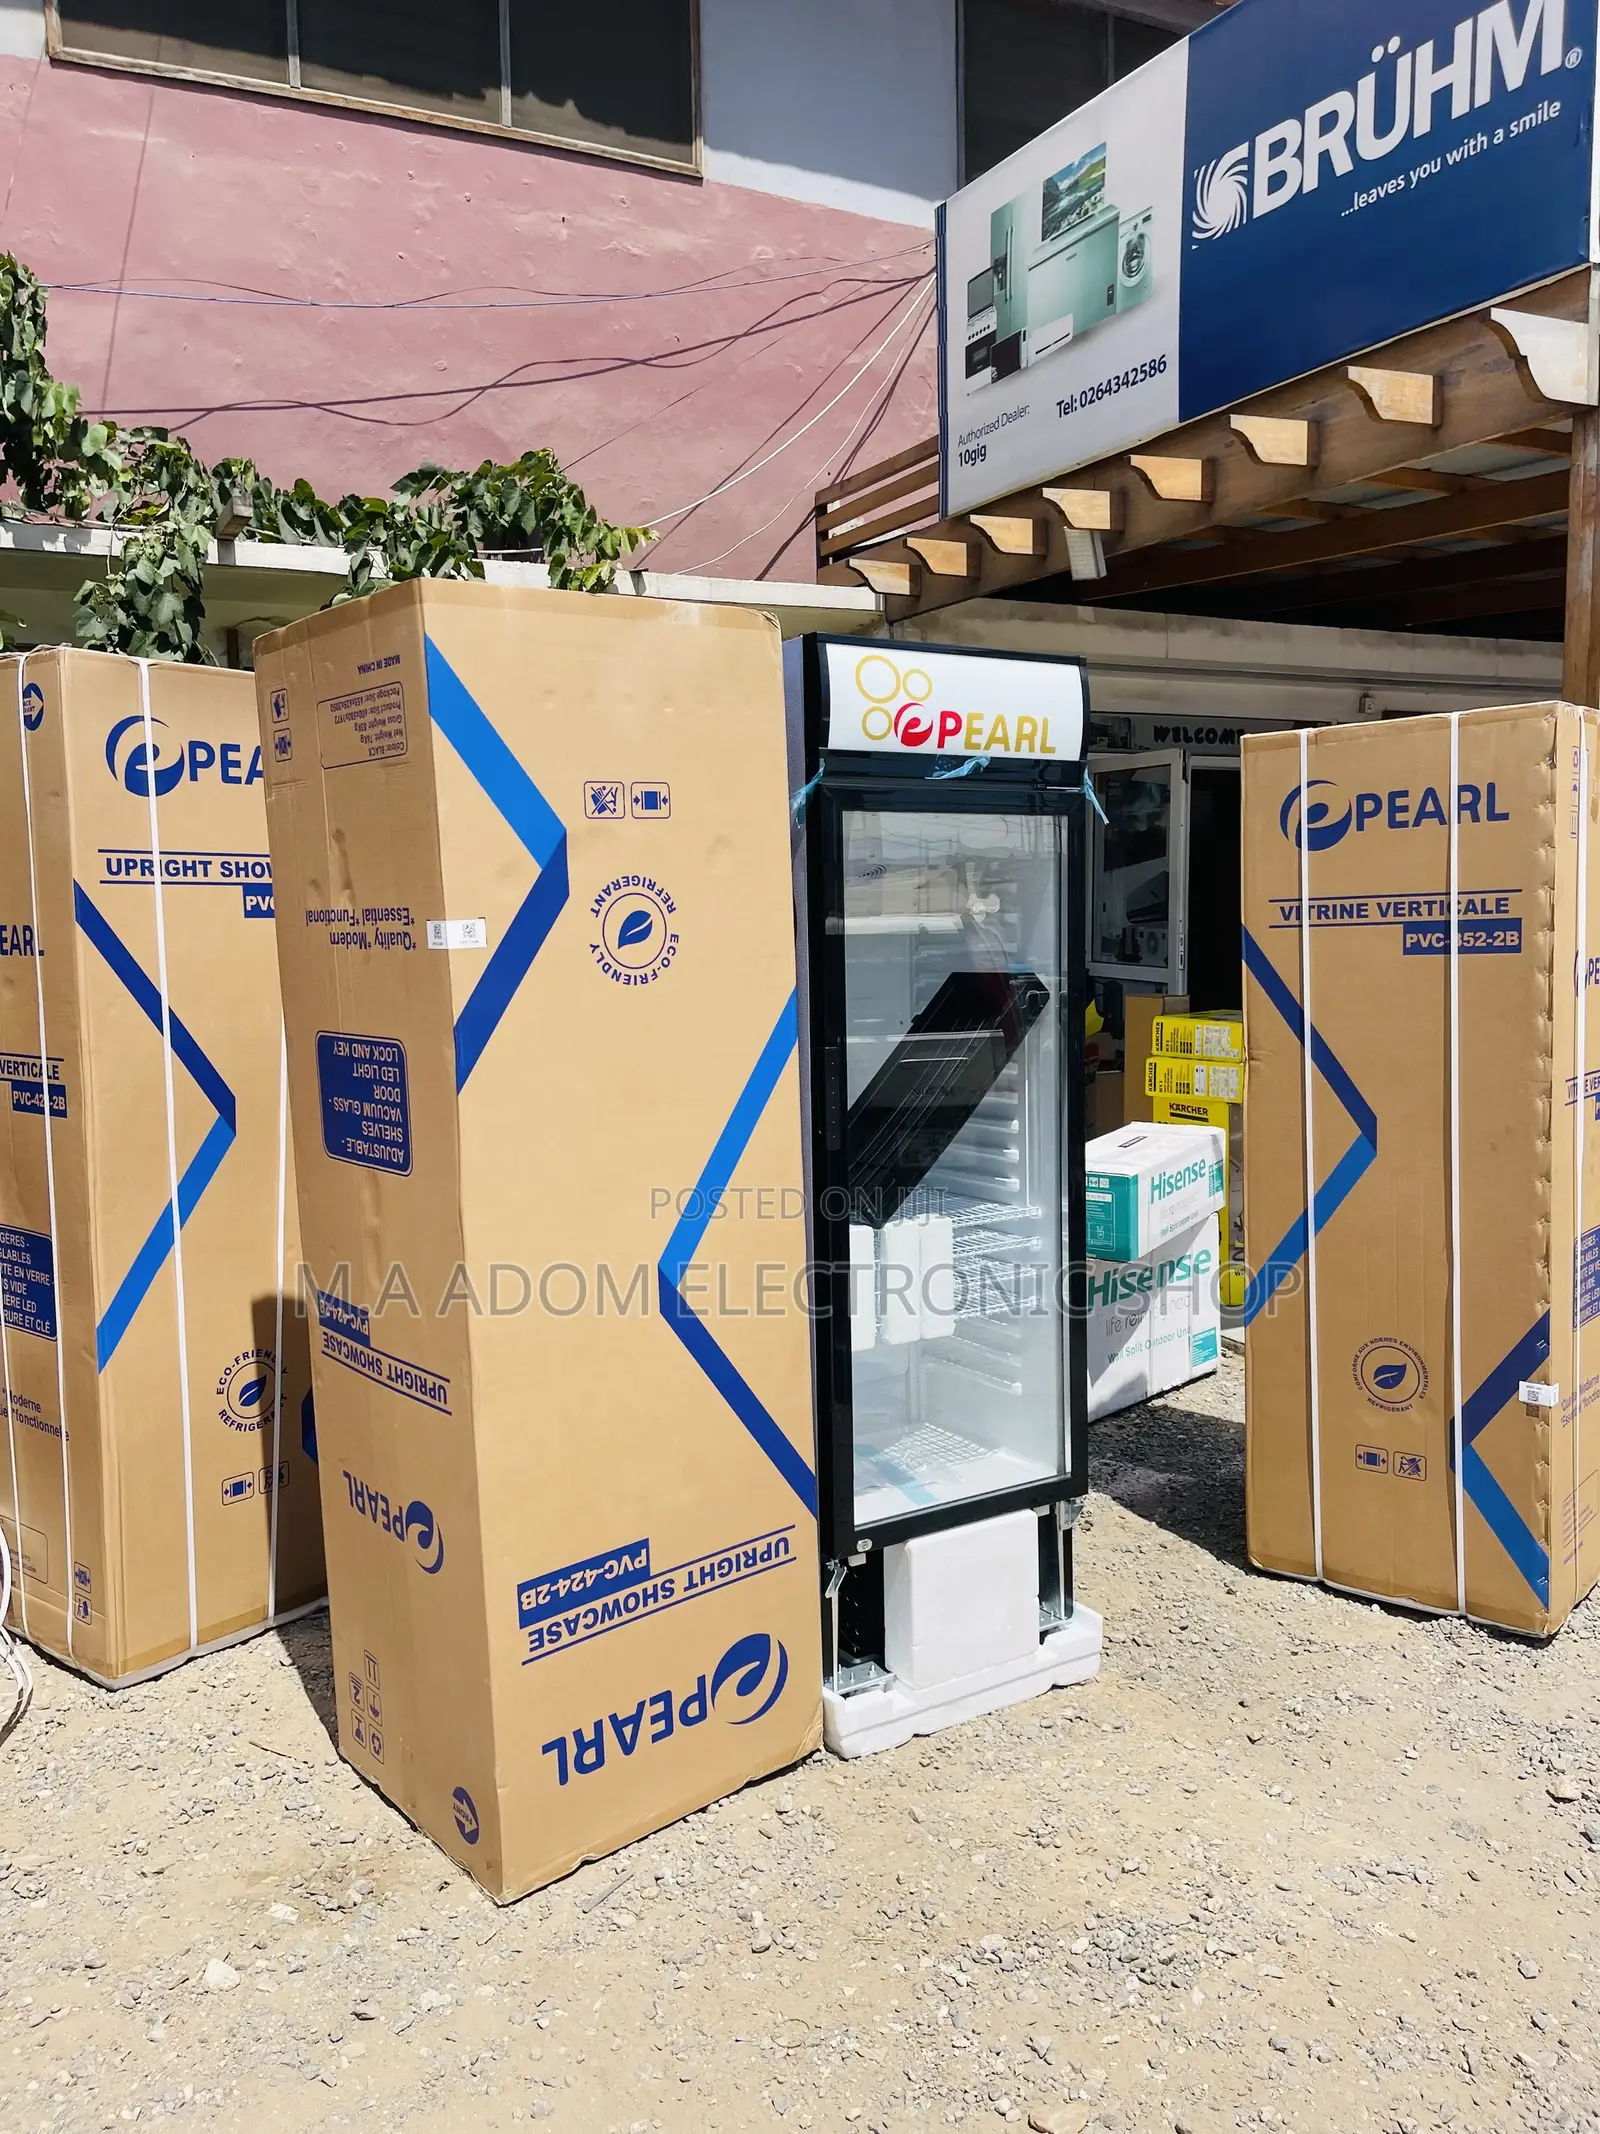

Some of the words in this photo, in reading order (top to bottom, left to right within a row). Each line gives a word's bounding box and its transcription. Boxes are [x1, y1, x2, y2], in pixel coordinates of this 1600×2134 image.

[1410, 157, 1441, 189] you
[1446, 132, 1488, 165] with
[1493, 128, 1504, 144] a
[1510, 100, 1561, 137] smile
[1056, 394, 1077, 418] Tel:
[1079, 354, 1168, 408] 0264342586
[958, 422, 1000, 448] Authorized
[1001, 404, 1030, 428] Dealer:
[958, 444, 986, 468] 10gig
[358, 662, 376, 675] CHINA
[376, 660, 383, 670] IN
[384, 655, 400, 667] MADE
[937, 709, 1056, 754] PEARL
[1356, 782, 1510, 832] PEARL
[590, 875, 676, 918] REFRIGERANT
[590, 934, 679, 986] ECO-FRIENDLY
[333, 1040, 350, 1056] KEY
[352, 1043, 370, 1060] AND
[372, 1045, 398, 1063] LOCK
[352, 1062, 379, 1079] LIGHT
[381, 1067, 400, 1082] LED
[13, 1090, 66, 1110] PVC-42-2B
[373, 1084, 401, 1103] DOOR
[333, 1096, 361, 1115] GLASS
[362, 1102, 403, 1123] VACUUM
[361, 1120, 404, 1143] SHELVES
[346, 1137, 404, 1164] ADJUSTABLE
[1150, 1158, 1206, 1204] Hisense
[14, 1266, 24, 1280] EN
[25, 1268, 50, 1286] VERRE
[1088, 1249, 1212, 1313] Hisense
[10, 1282, 28, 1296] VIDE
[22, 1300, 37, 1314] LED
[25, 1315, 34, 1328] ET
[36, 1319, 50, 1334] CLÉ
[1106, 1315, 1122, 1337] life
[1125, 1343, 1142, 1358] Split
[1144, 1332, 1175, 1349] Outdoor
[322, 1332, 383, 1376] SHOWCASE
[386, 1363, 448, 1405] UPRIGHT
[343, 1470, 405, 1544] PEARL
[520, 1548, 649, 1610] PVC-424-2B
[528, 1580, 676, 1653] SHOWCASE
[683, 1536, 792, 1595] UPRIGHT
[542, 1675, 708, 1788] PEARL
